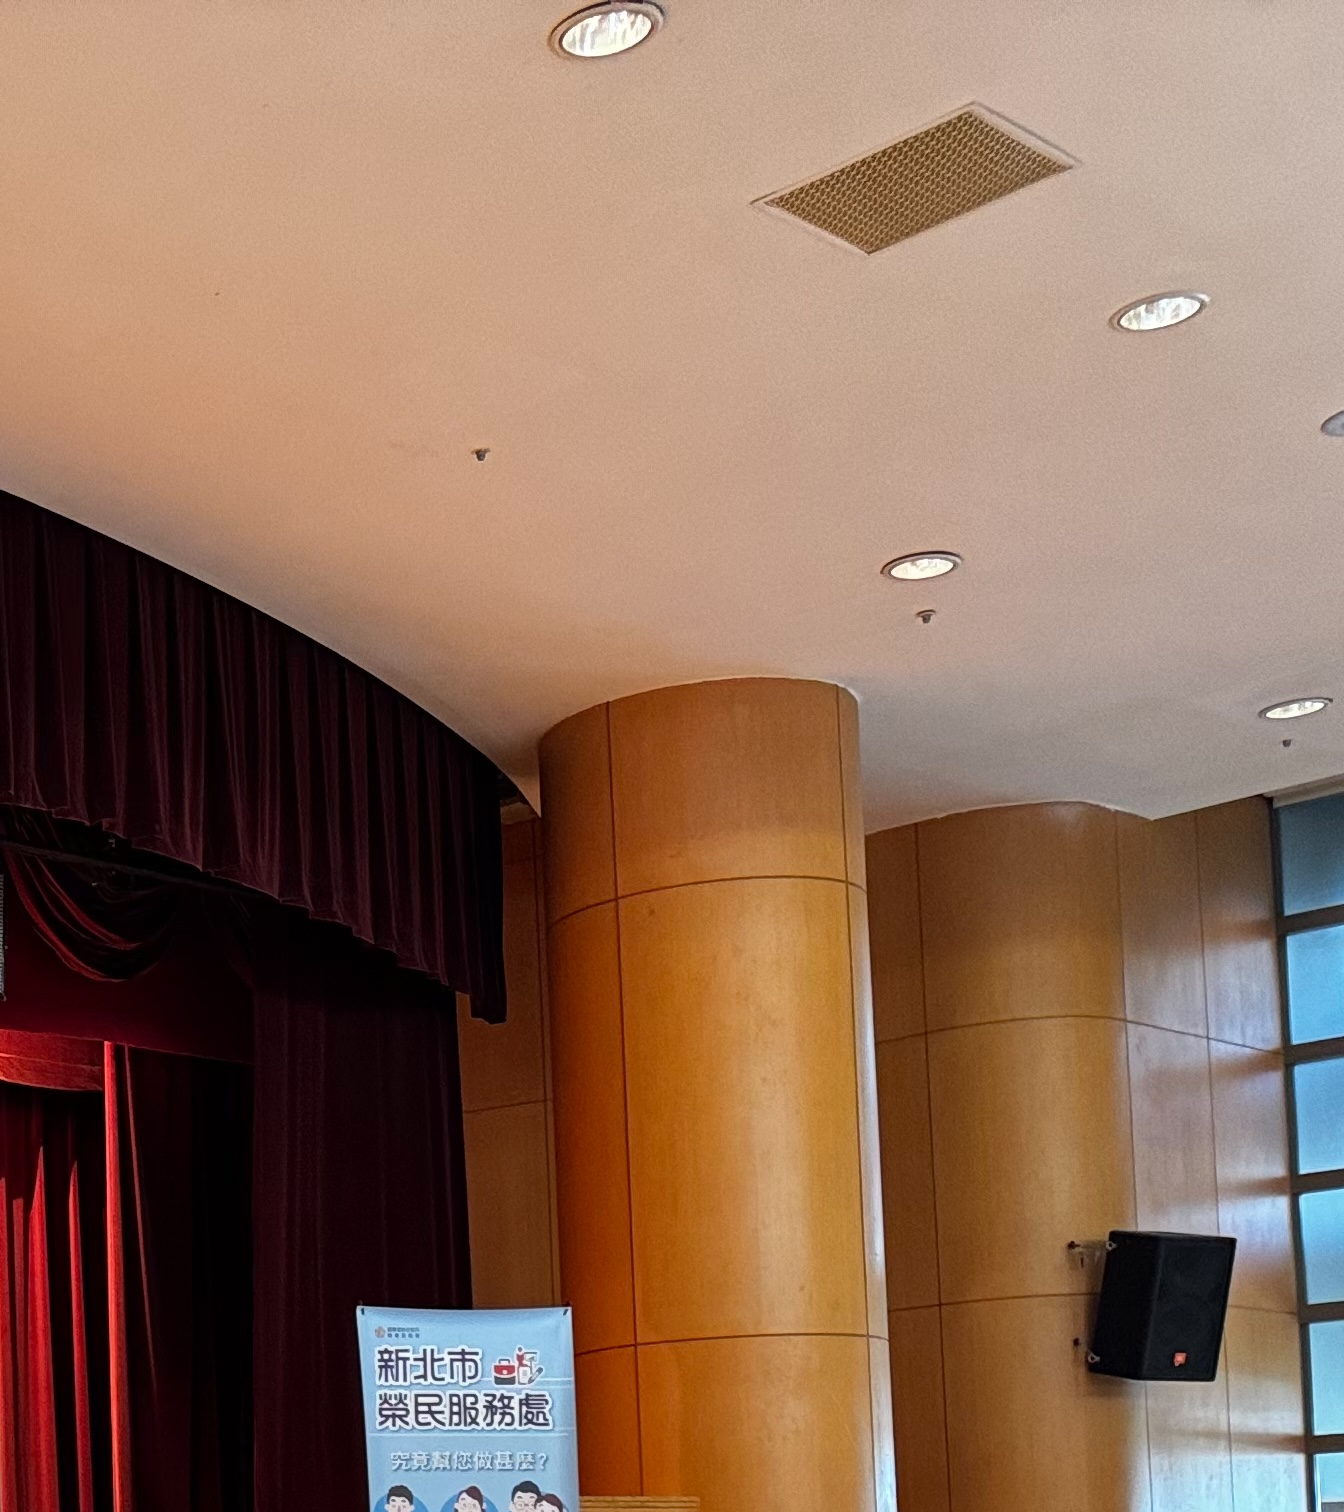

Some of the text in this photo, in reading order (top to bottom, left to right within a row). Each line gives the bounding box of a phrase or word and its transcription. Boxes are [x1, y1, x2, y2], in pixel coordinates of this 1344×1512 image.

[376, 1347, 481, 1384] 新北市
[377, 1391, 551, 1428] 榮民服務處
